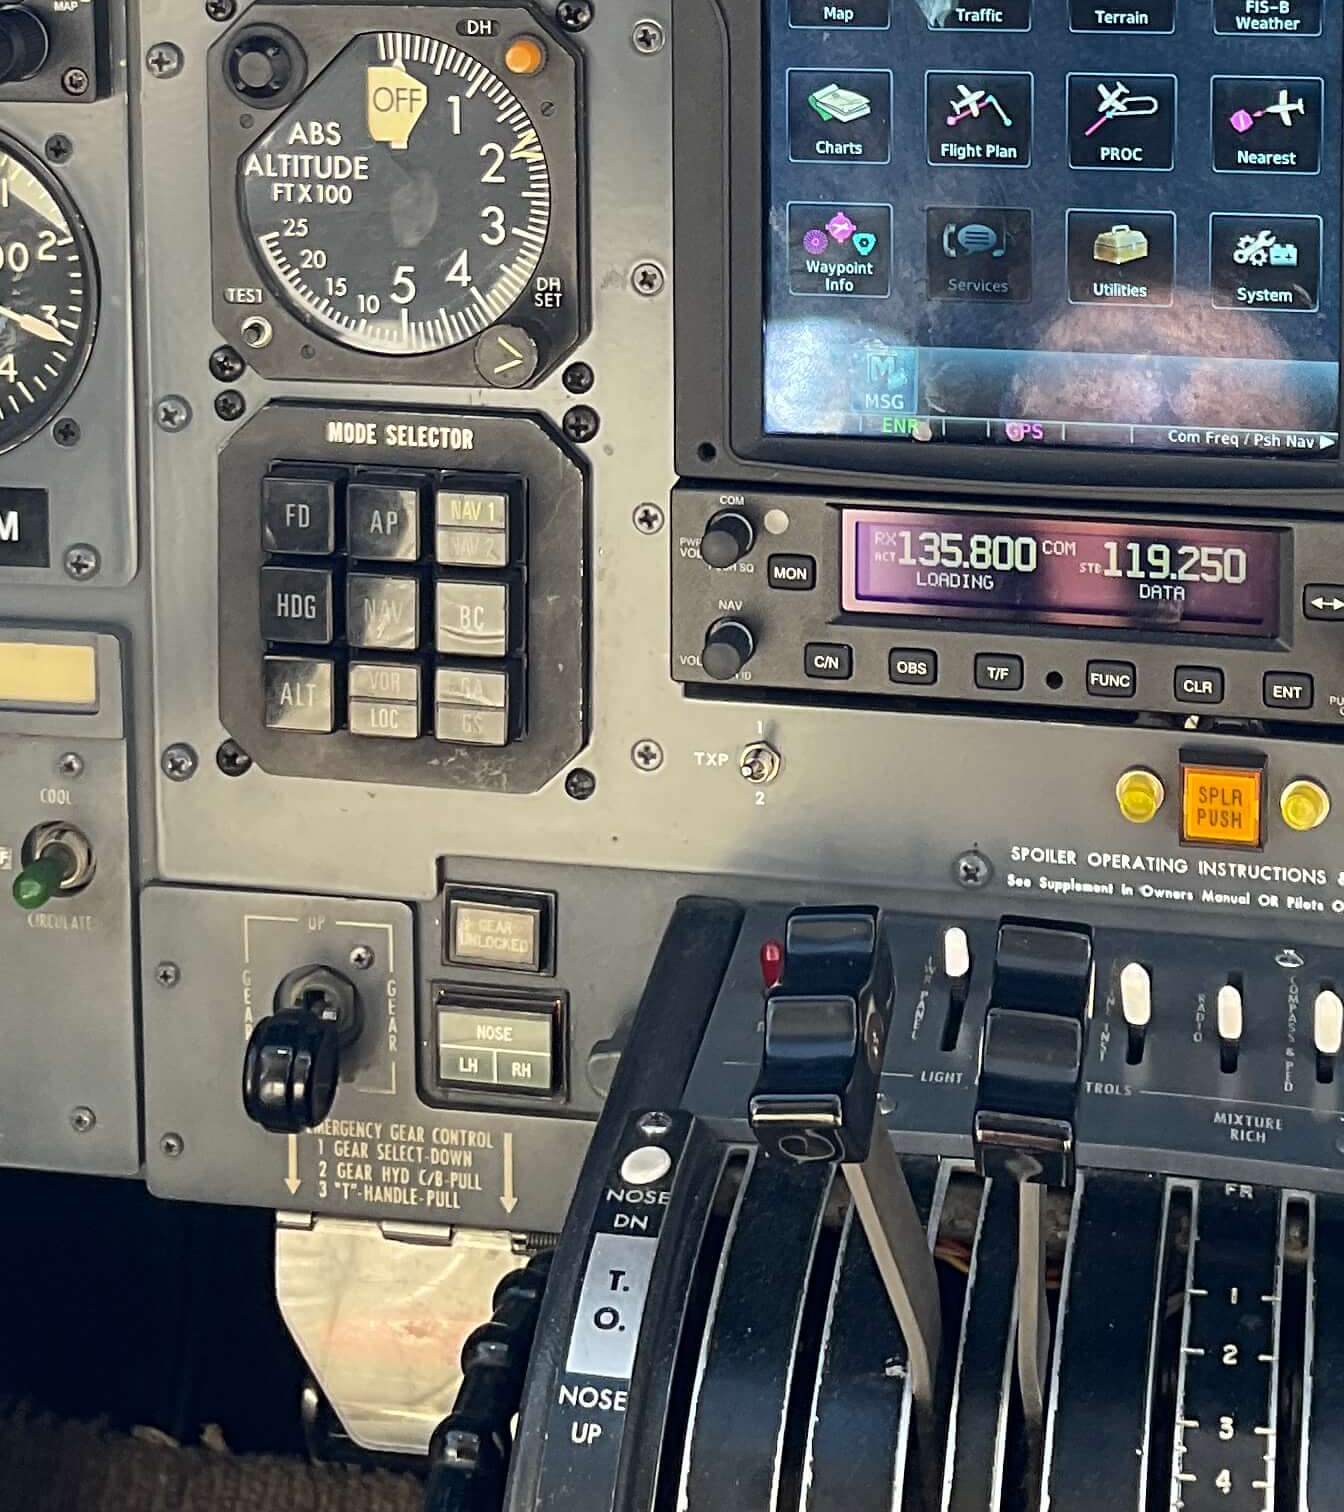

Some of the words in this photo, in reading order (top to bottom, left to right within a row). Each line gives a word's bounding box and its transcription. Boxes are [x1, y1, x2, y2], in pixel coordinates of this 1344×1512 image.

[823, 7, 855, 24] Map
[956, 7, 1003, 23] Traffic
[1095, 10, 1149, 25] Terrain
[1236, 16, 1301, 31] Weather
[373, 87, 422, 113] OFF
[289, 122, 341, 145] ABS
[816, 141, 862, 156] Charts
[940, 143, 981, 161] Flight
[985, 144, 1017, 159] Plan
[244, 154, 369, 180] ALTITUDE
[1237, 150, 1296, 166] Nearest
[806, 261, 873, 278] Waypoint
[1093, 283, 1147, 298] Utilities
[1237, 288, 1292, 304] System
[327, 422, 377, 445] MODE
[386, 425, 474, 450] SELECTOR
[899, 531, 1036, 572] 135.800
[1103, 543, 1247, 583] 119.250
[916, 572, 993, 590] LOADING
[1140, 585, 1185, 601] DATA
[1089, 673, 1131, 688] FUNC
[1273, 685, 1303, 700] ENT
[1198, 786, 1242, 807] SPLR
[1197, 809, 1242, 829] PUSH
[1011, 847, 1076, 864] SPOILER
[1088, 852, 1188, 873] OPERATING
[1198, 860, 1326, 885] INSTRUCTIONS
[559, 1386, 628, 1410] NOSE
[571, 1421, 603, 1444] UP
